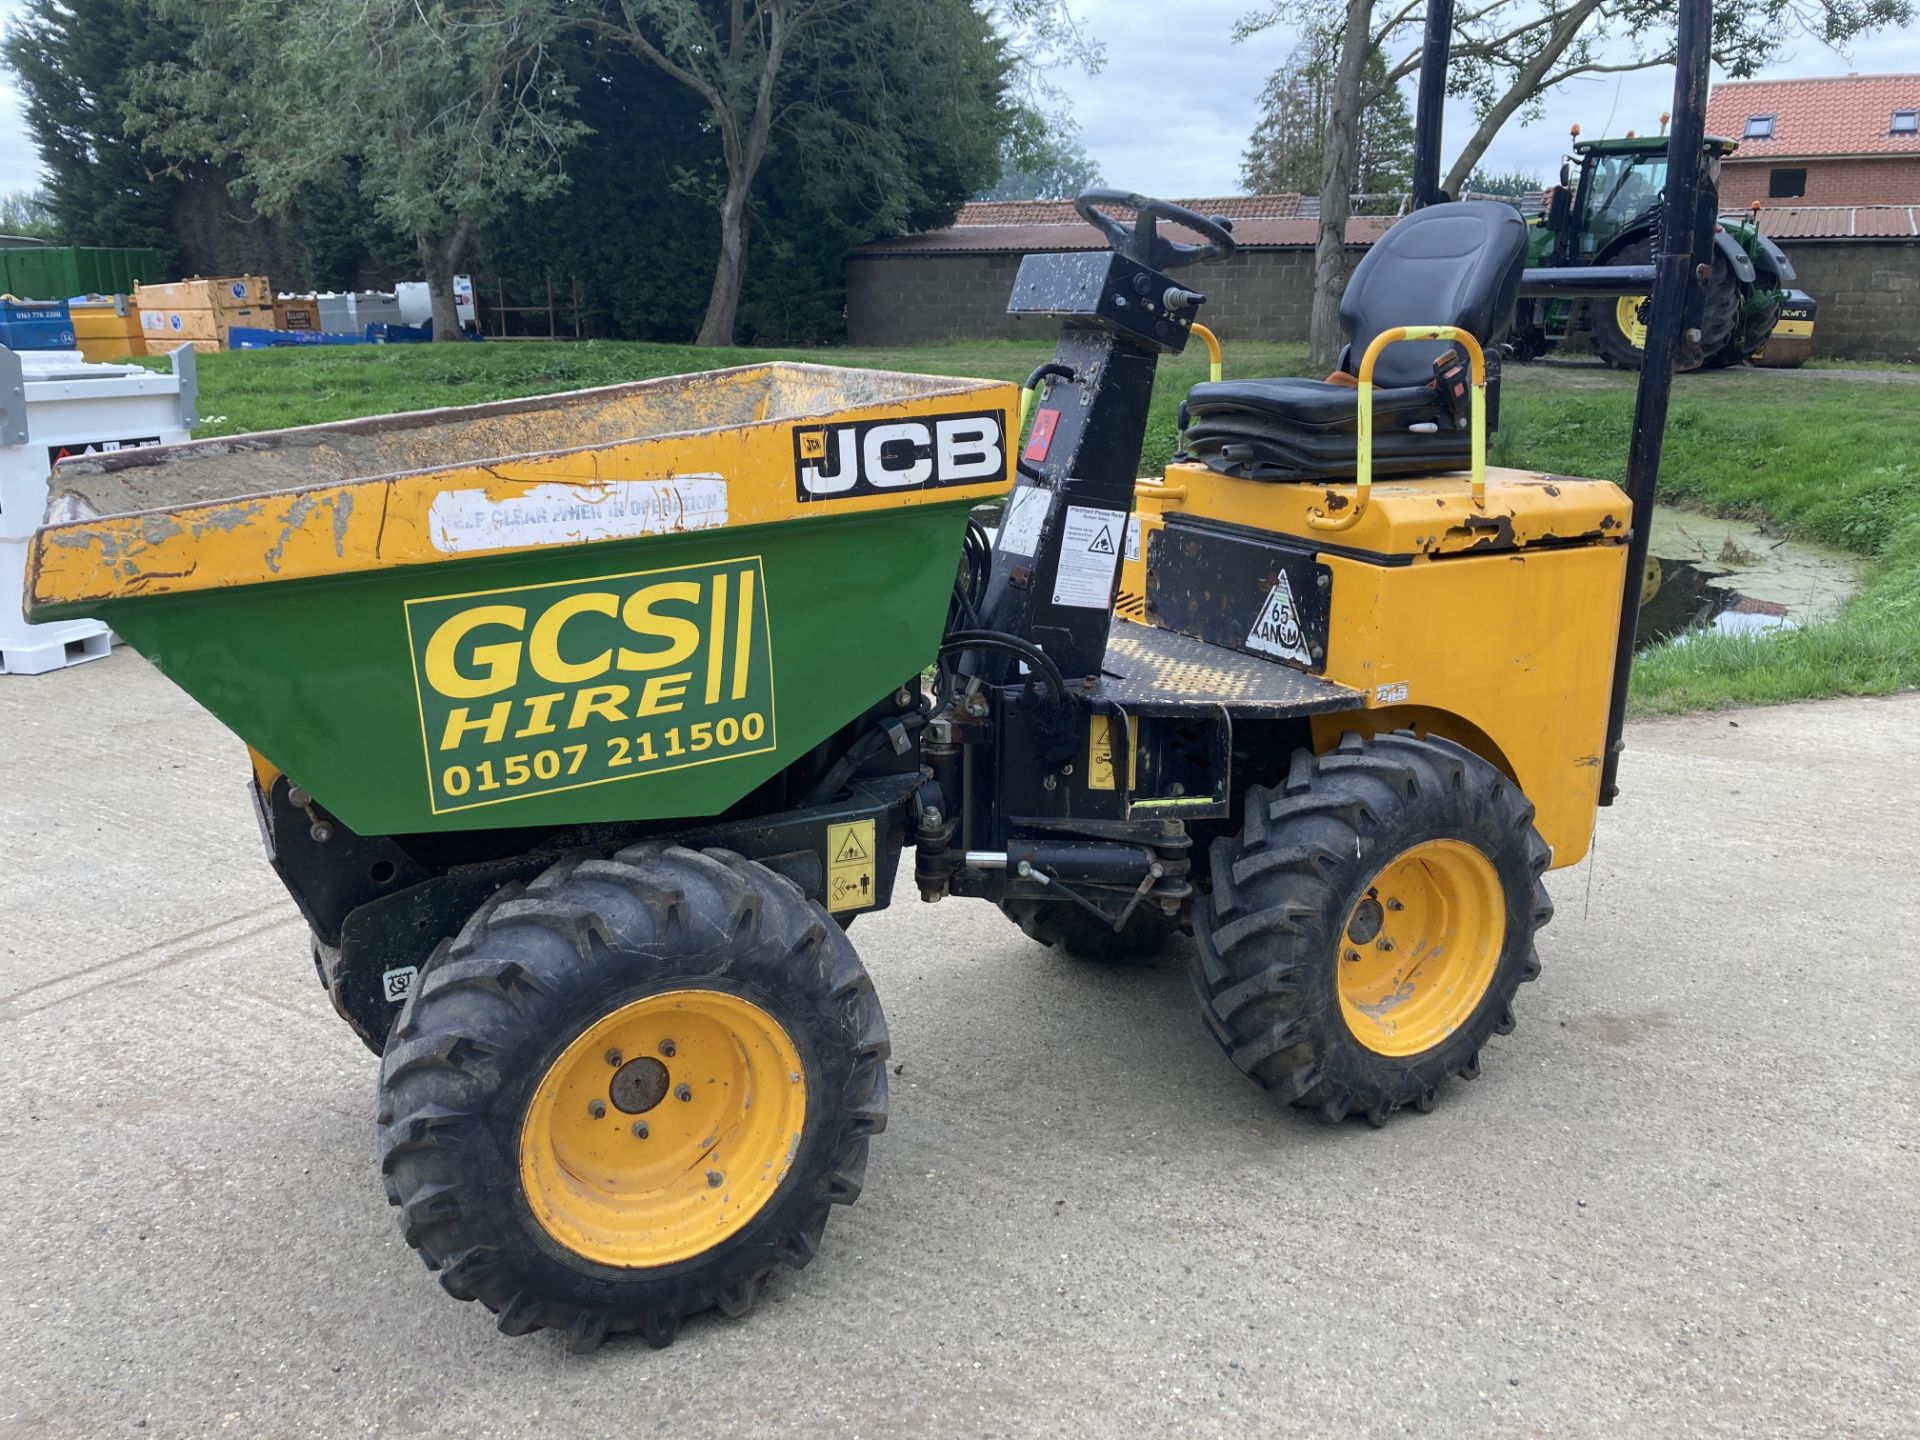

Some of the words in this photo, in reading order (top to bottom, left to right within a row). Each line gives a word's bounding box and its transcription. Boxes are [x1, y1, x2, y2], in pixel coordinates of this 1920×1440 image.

[801, 417, 1002, 493] JCB
[805, 438, 821, 452] JCB
[491, 506, 549, 526] CLEAR
[552, 503, 602, 523] WHEN
[630, 493, 718, 517] OPERATION
[424, 582, 701, 698] GCS
[1272, 603, 1289, 625] 65
[440, 672, 692, 751] HIRE
[443, 744, 588, 796] 01507
[607, 712, 765, 768] 211500
